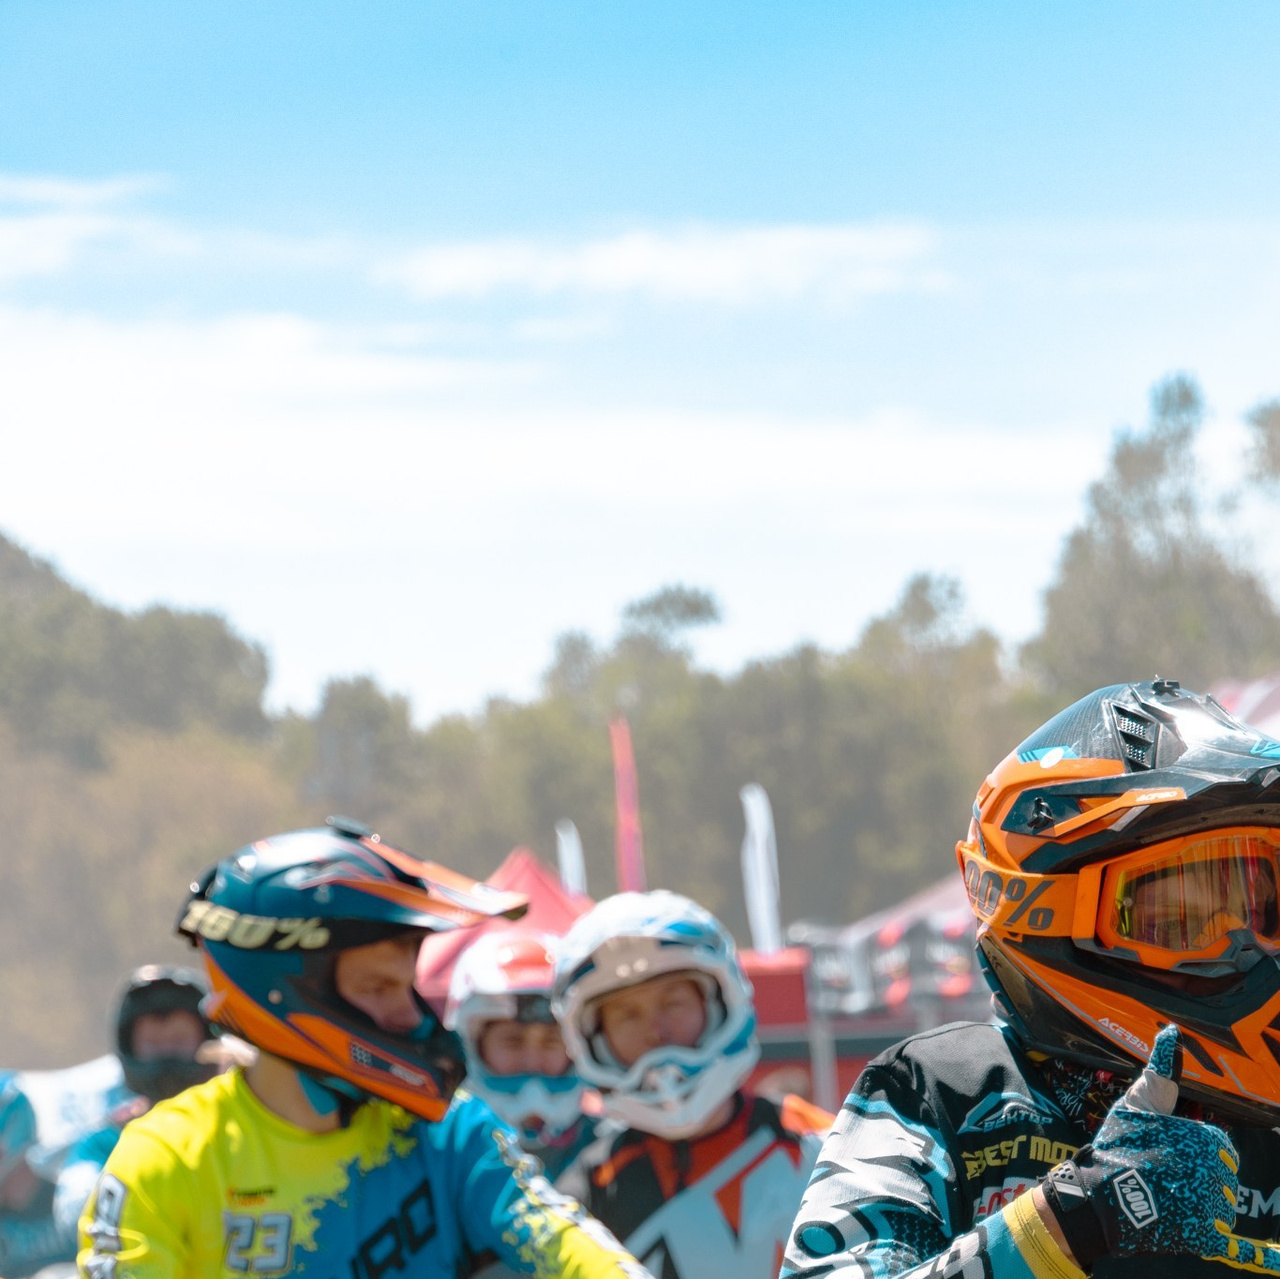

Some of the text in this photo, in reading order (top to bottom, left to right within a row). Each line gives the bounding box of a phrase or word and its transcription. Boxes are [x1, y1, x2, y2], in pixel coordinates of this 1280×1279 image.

[964, 858, 1056, 931] 00%
[181, 901, 331, 950] 100%
[1097, 1017, 1150, 1053] ACERBIS
[1119, 1178, 1152, 1220] 100%
